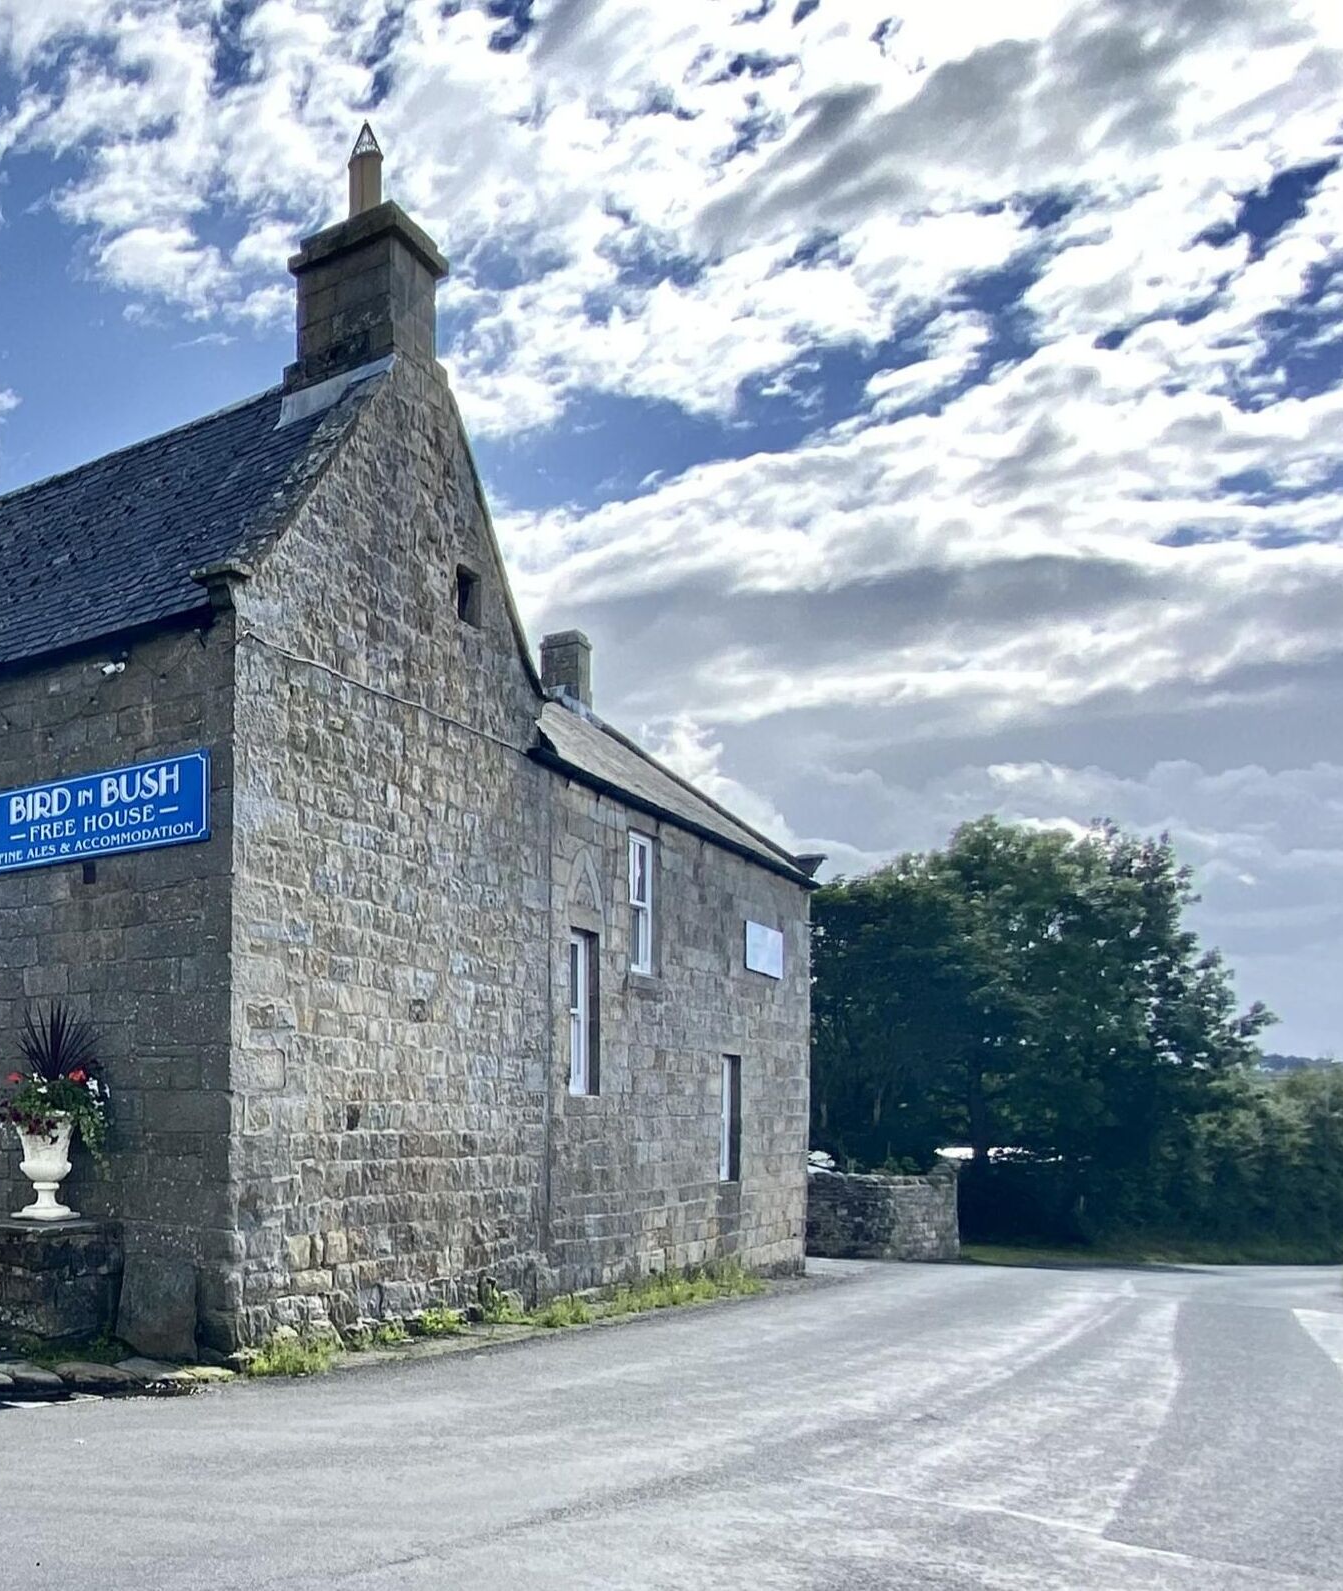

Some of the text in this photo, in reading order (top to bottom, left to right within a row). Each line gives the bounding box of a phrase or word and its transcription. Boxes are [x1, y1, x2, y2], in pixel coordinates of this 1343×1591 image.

[10, 764, 179, 825] BIRD IN BUSH
[27, 845, 56, 860] ALES
[60, 842, 72, 854] &
[74, 821, 194, 851] ACCOMMODATION
[30, 804, 155, 842] FREE HOUSE
